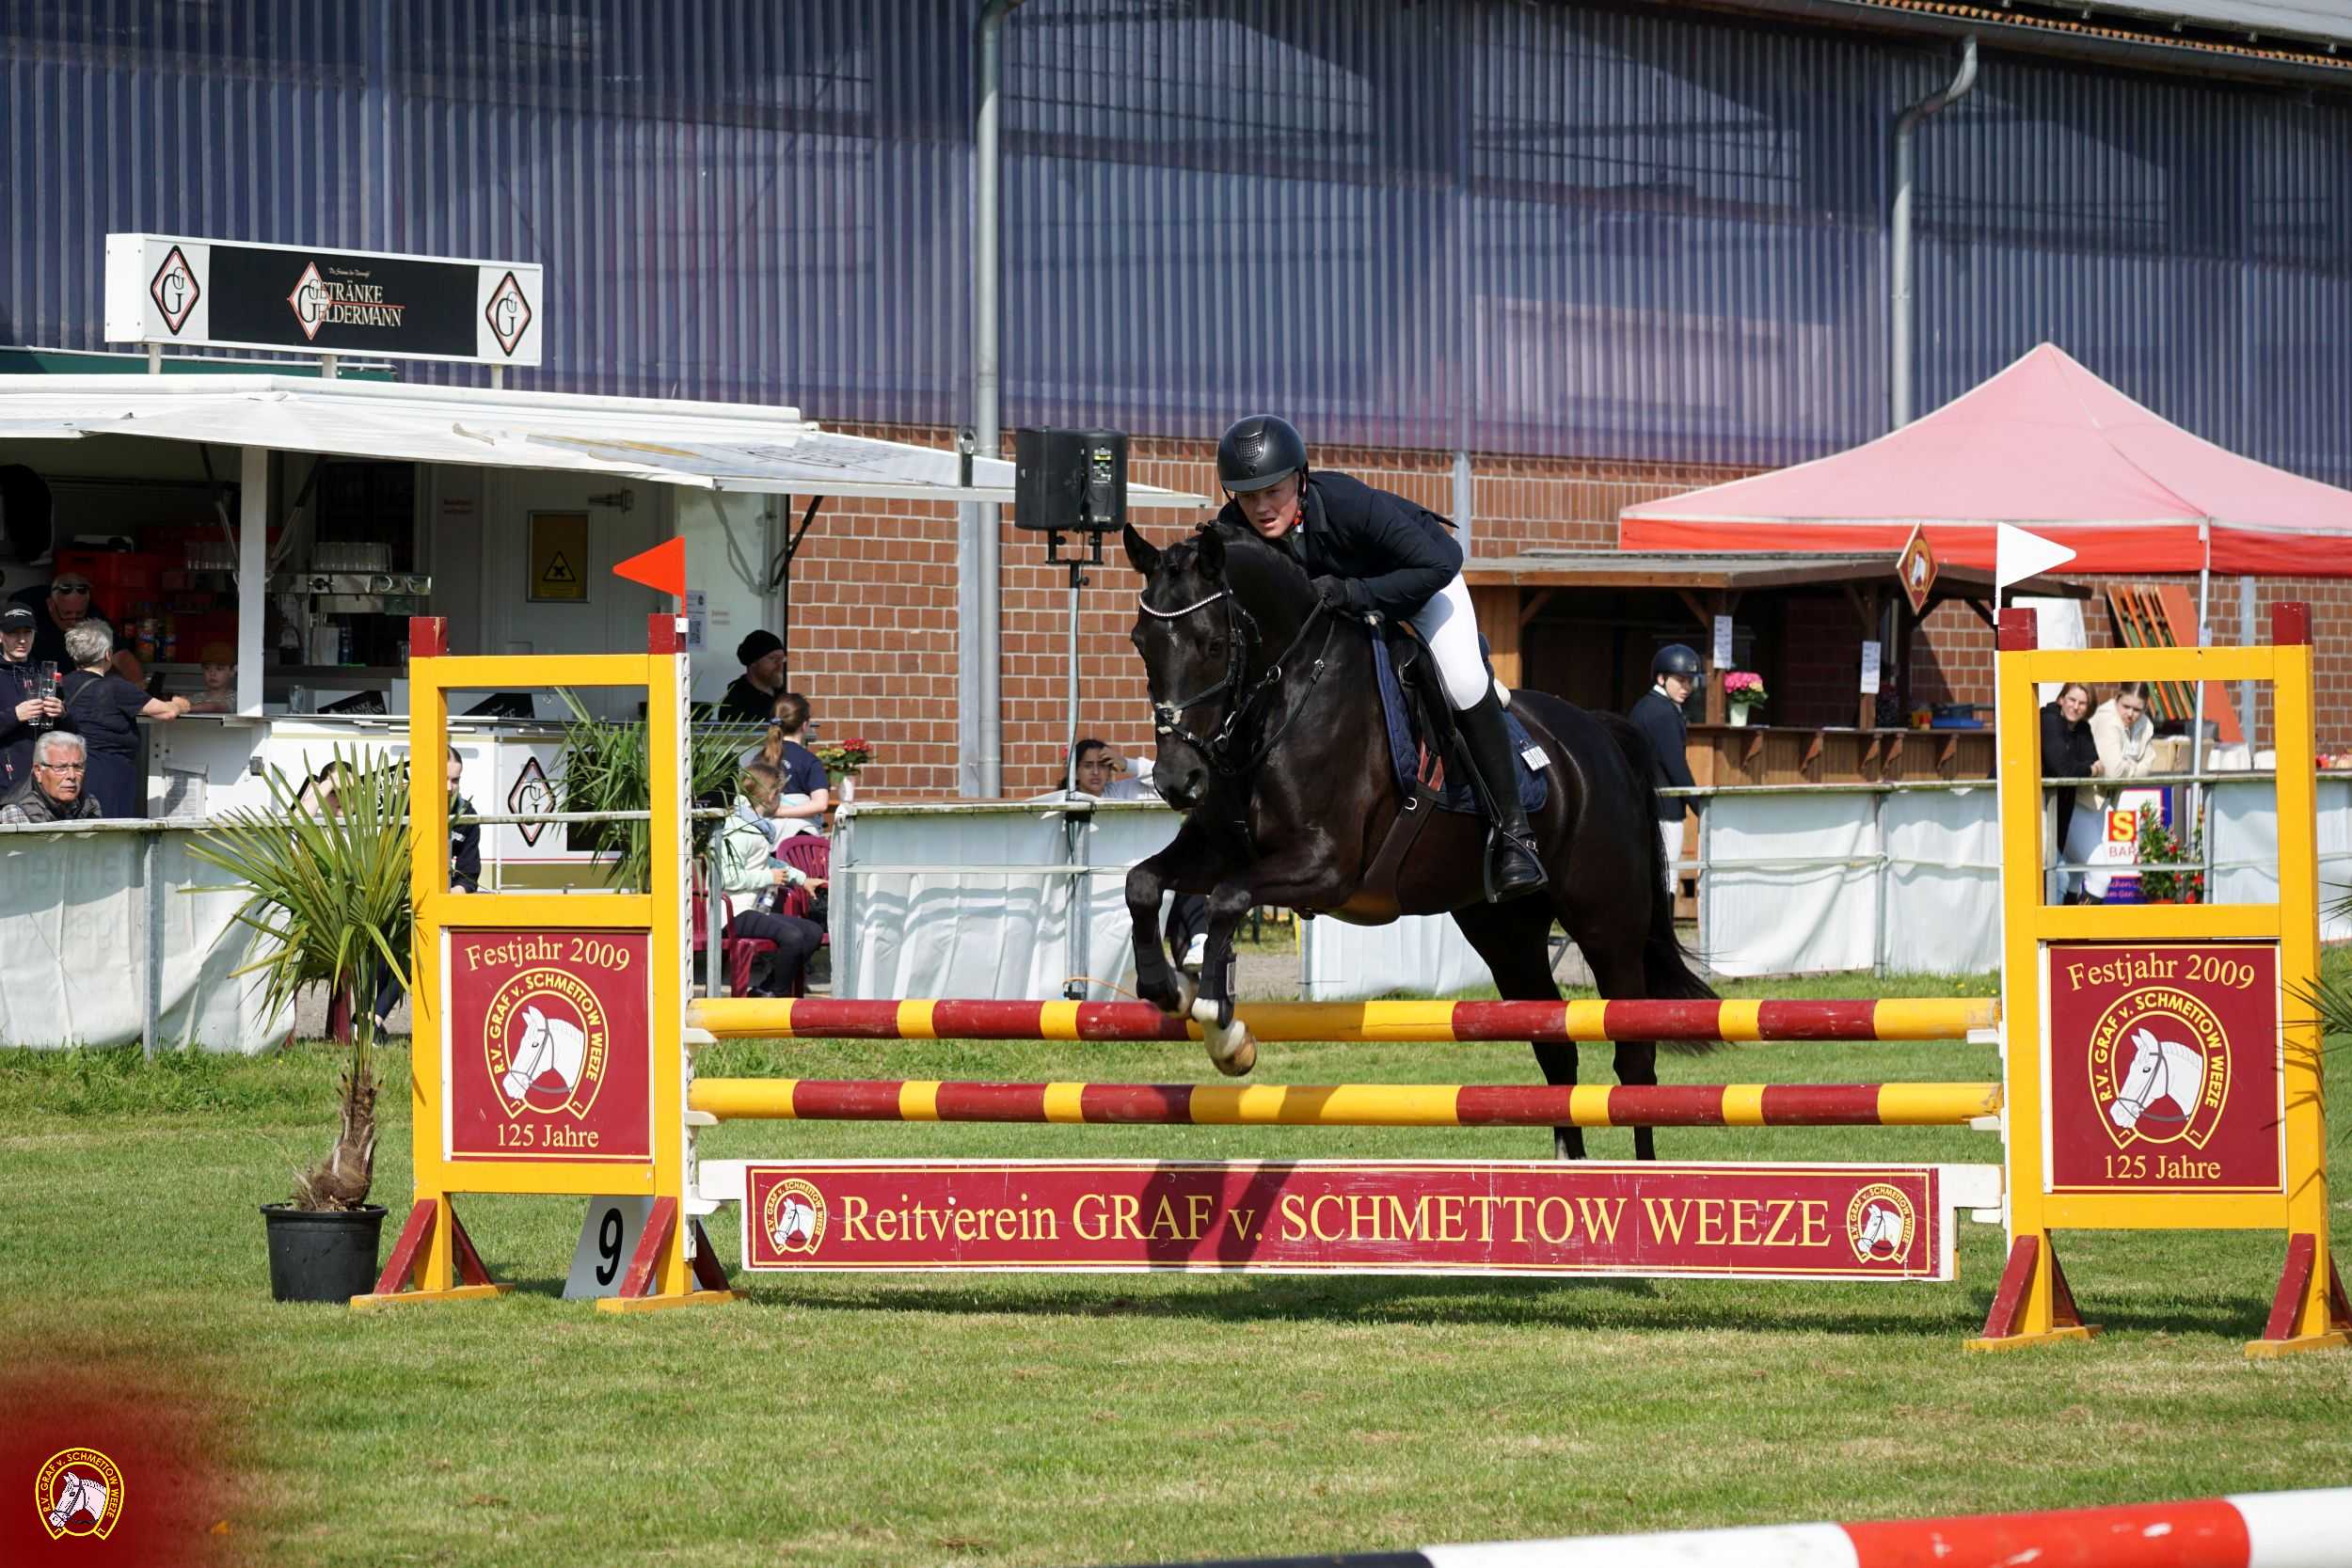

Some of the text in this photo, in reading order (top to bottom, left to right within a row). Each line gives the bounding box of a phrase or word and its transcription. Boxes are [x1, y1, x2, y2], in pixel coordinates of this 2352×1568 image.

[298, 285, 402, 327] GELDERMANN
[309, 279, 383, 304] GETRÄNKE
[465, 936, 630, 972] Festjahr 2009
[2067, 952, 2255, 990] Festjahr 2009
[489, 994, 511, 1039] GRAF
[511, 987, 524, 998] v.
[526, 973, 600, 1026] SCHMETTOW
[586, 1032, 603, 1082] WEEZE
[2094, 1015, 2119, 1064] GRAF
[2119, 1006, 2134, 1019] v.
[2135, 992, 2222, 1050] SCHMETTOW
[2204, 1055, 2224, 1109] WEEZE
[498, 1123, 599, 1148] 125 Jahre
[2105, 1155, 2221, 1180] 125 Jahre
[840, 1194, 1832, 1247] Reitverein GRAF v. SCHMETTOW WEEZE
[596, 1208, 624, 1286] 9
